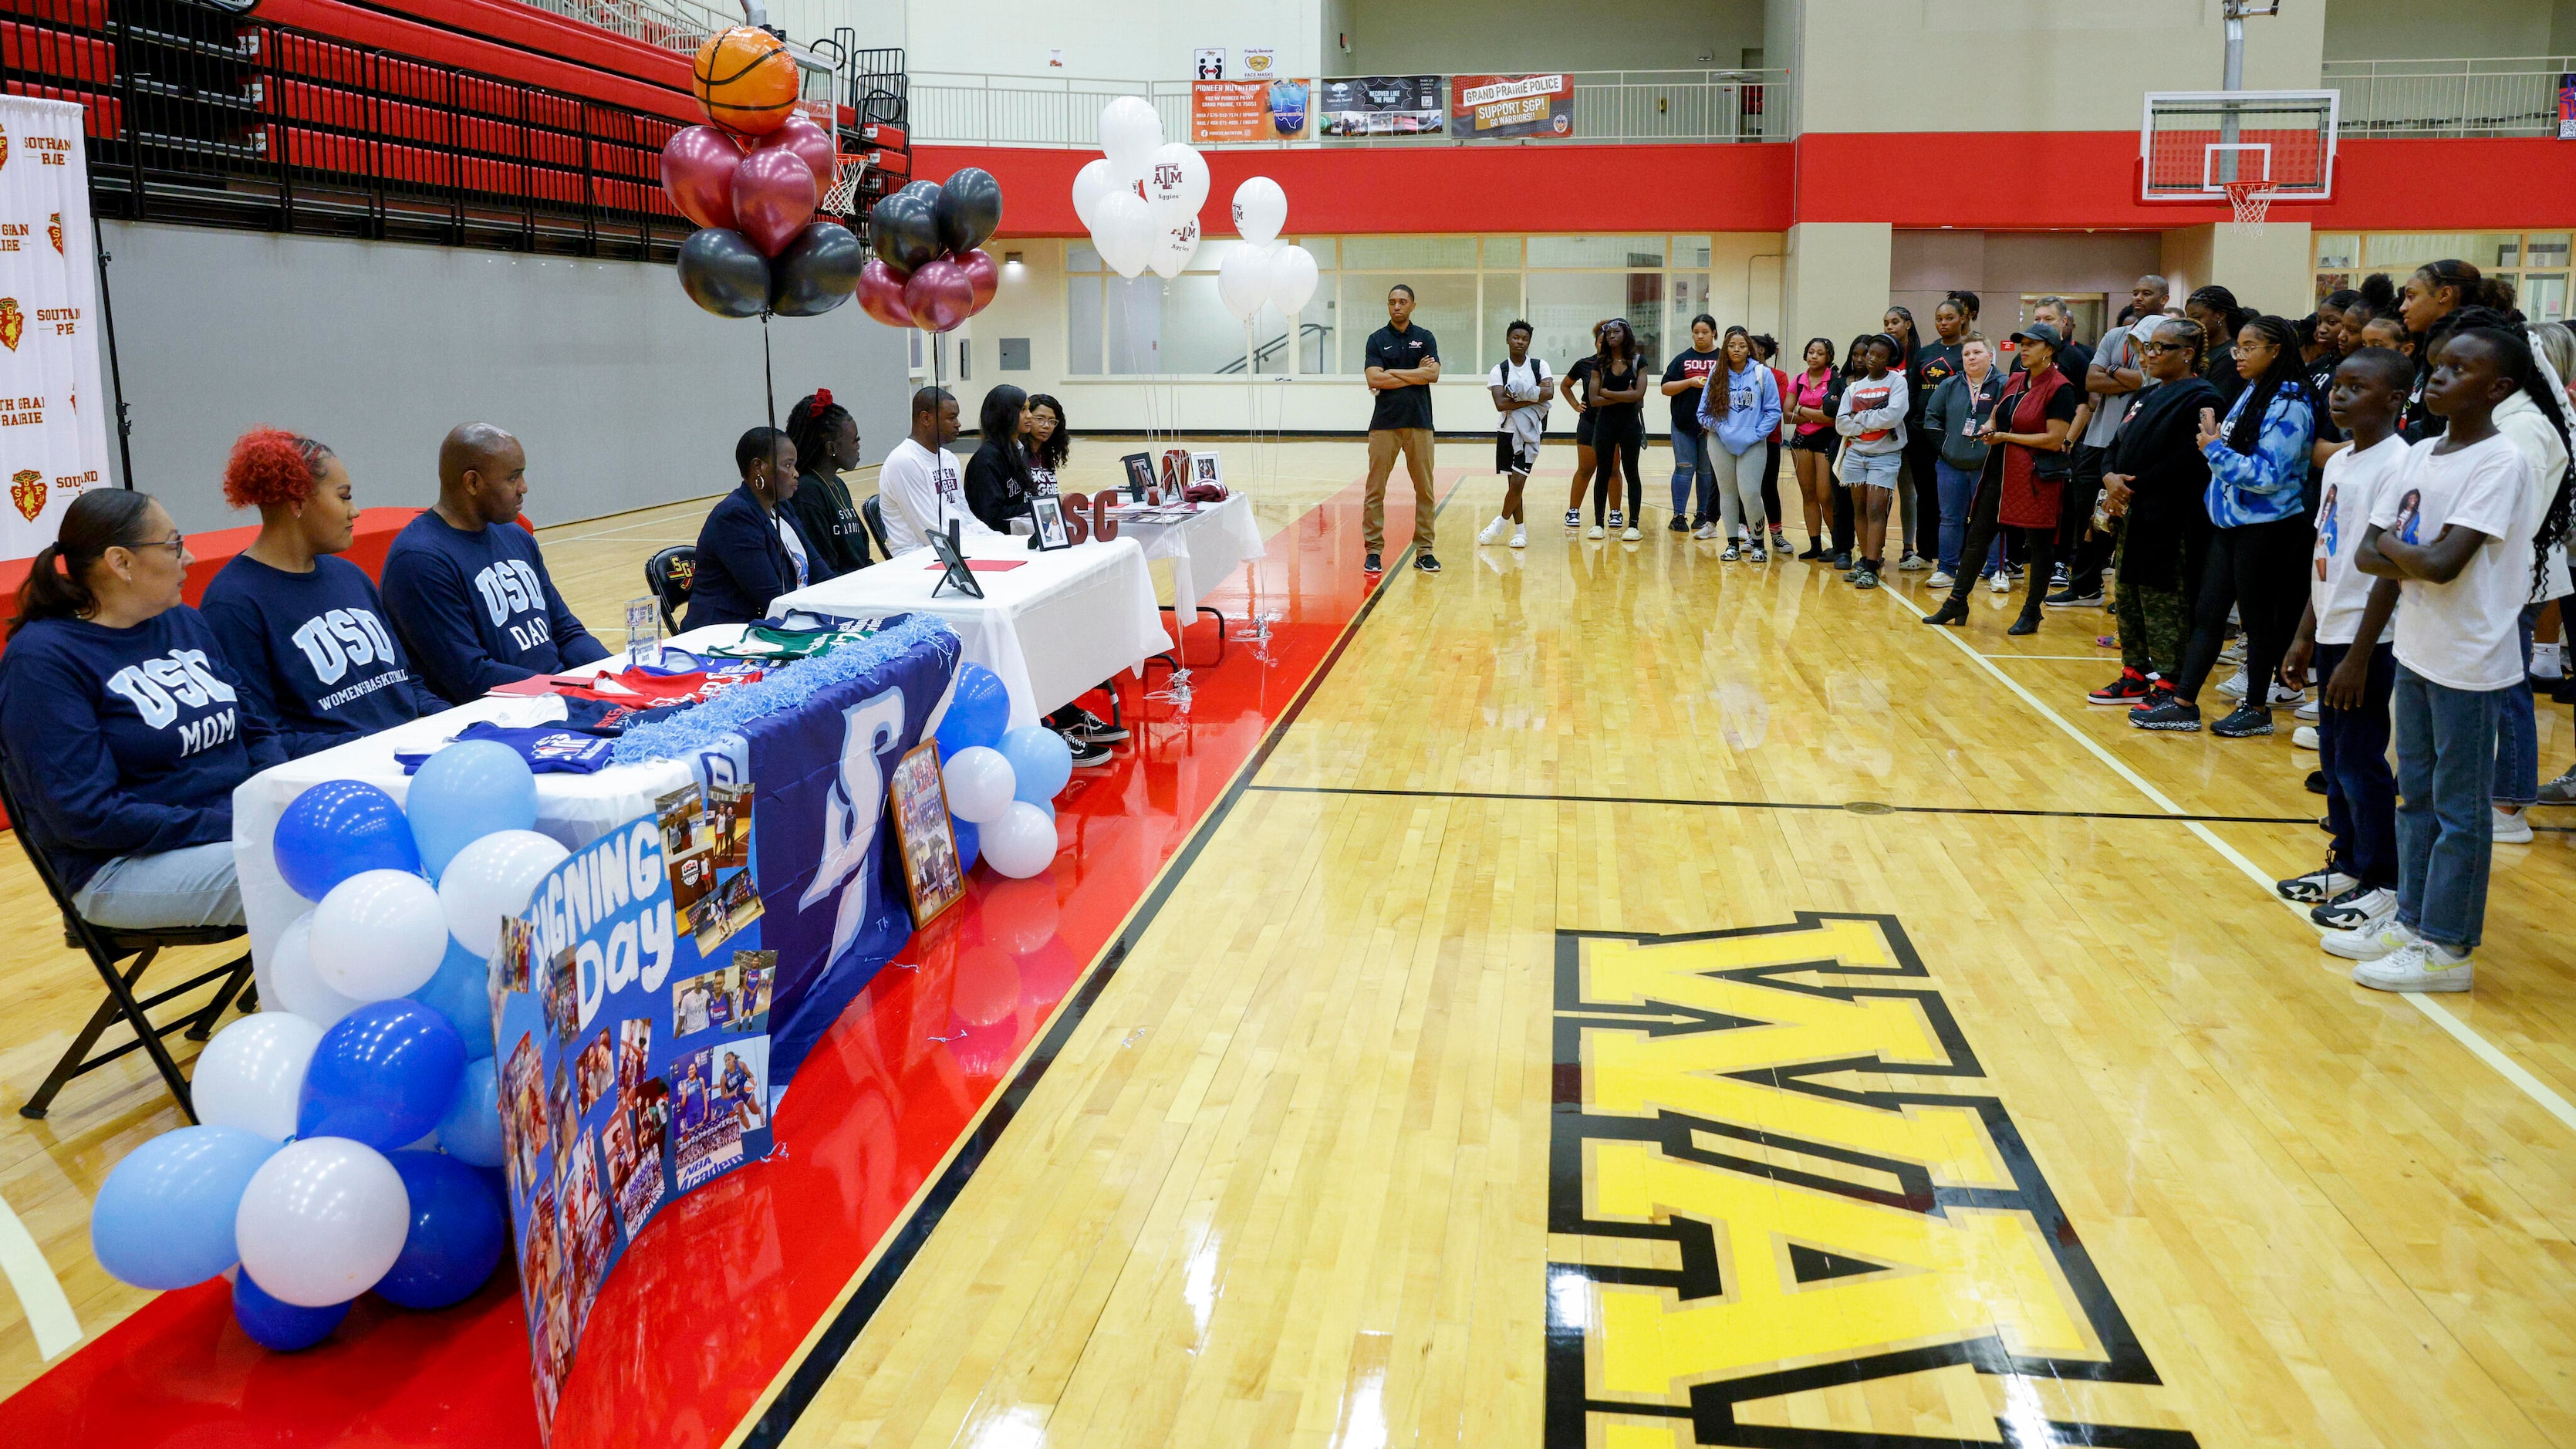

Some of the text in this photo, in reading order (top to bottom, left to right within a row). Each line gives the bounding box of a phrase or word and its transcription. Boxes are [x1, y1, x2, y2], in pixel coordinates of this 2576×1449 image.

[1466, 77, 1559, 103] GRAND PRAIRIE POLICE
[1478, 97, 1545, 120] SUPPORT SGP!
[1490, 112, 1535, 127] GO WARRIORS!!
[1683, 360, 1717, 371] SOUT
[474, 559, 546, 628] USD
[291, 607, 396, 686] USD
[508, 616, 550, 651] DAD
[106, 648, 238, 730] USD
[177, 707, 236, 758] MOM
[532, 820, 661, 992] SIGNING
[575, 899, 675, 1033] Day
[682, 1156, 713, 1182] NBA
[1544, 910, 2206, 1449] WA
